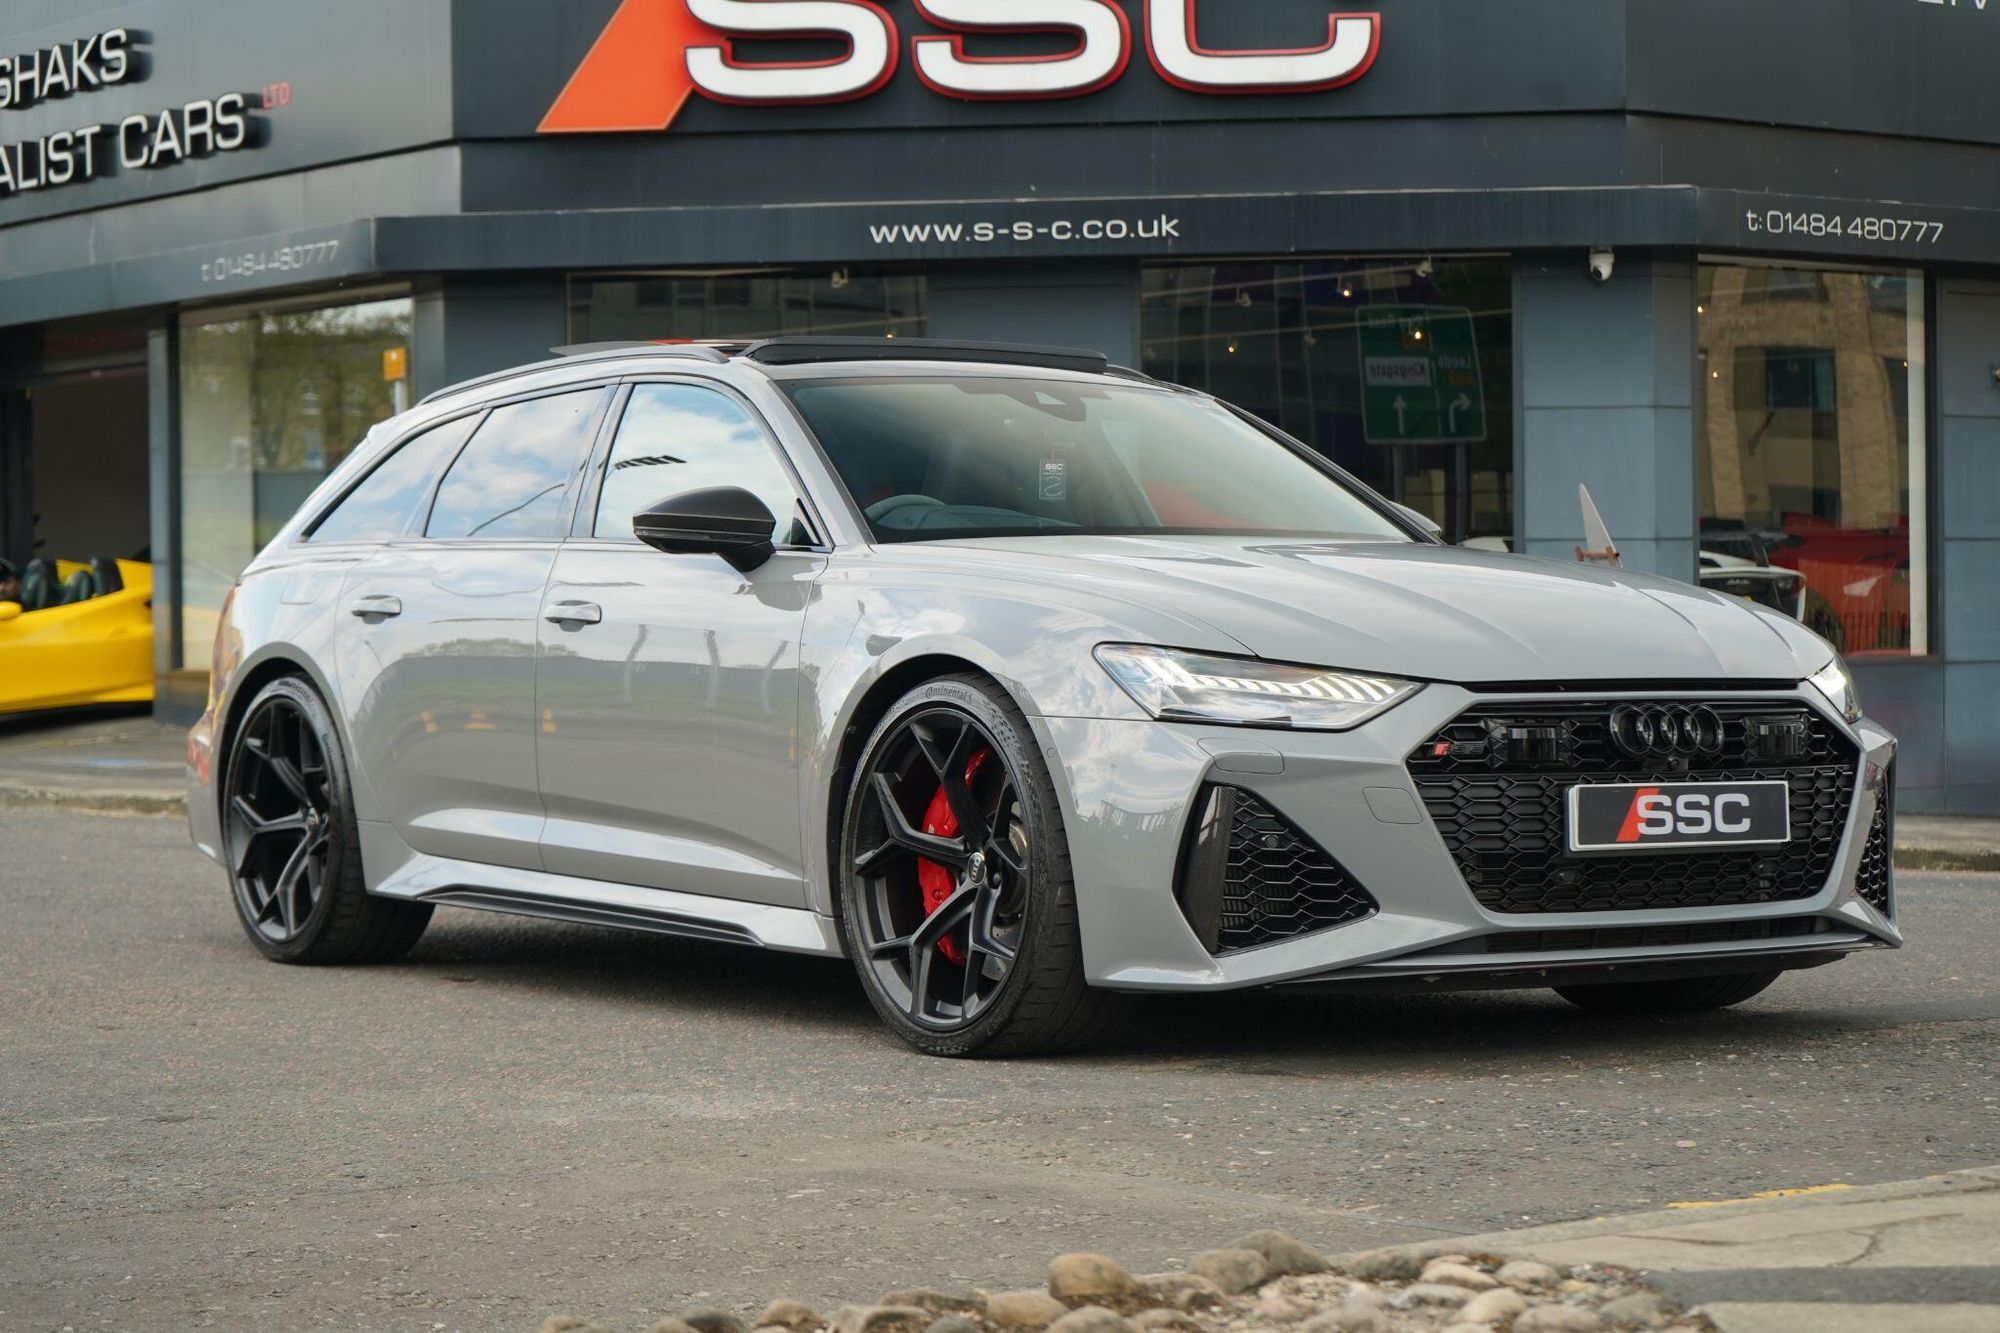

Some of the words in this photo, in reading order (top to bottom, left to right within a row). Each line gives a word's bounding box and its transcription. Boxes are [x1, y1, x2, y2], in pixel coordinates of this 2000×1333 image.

[119, 93, 246, 169] CARS
[262, 81, 291, 109] LTD
[869, 214, 1180, 244] www.s-s-c.co.uk
[926, 685, 967, 702] Continental
[1637, 793, 1751, 835] SSC
